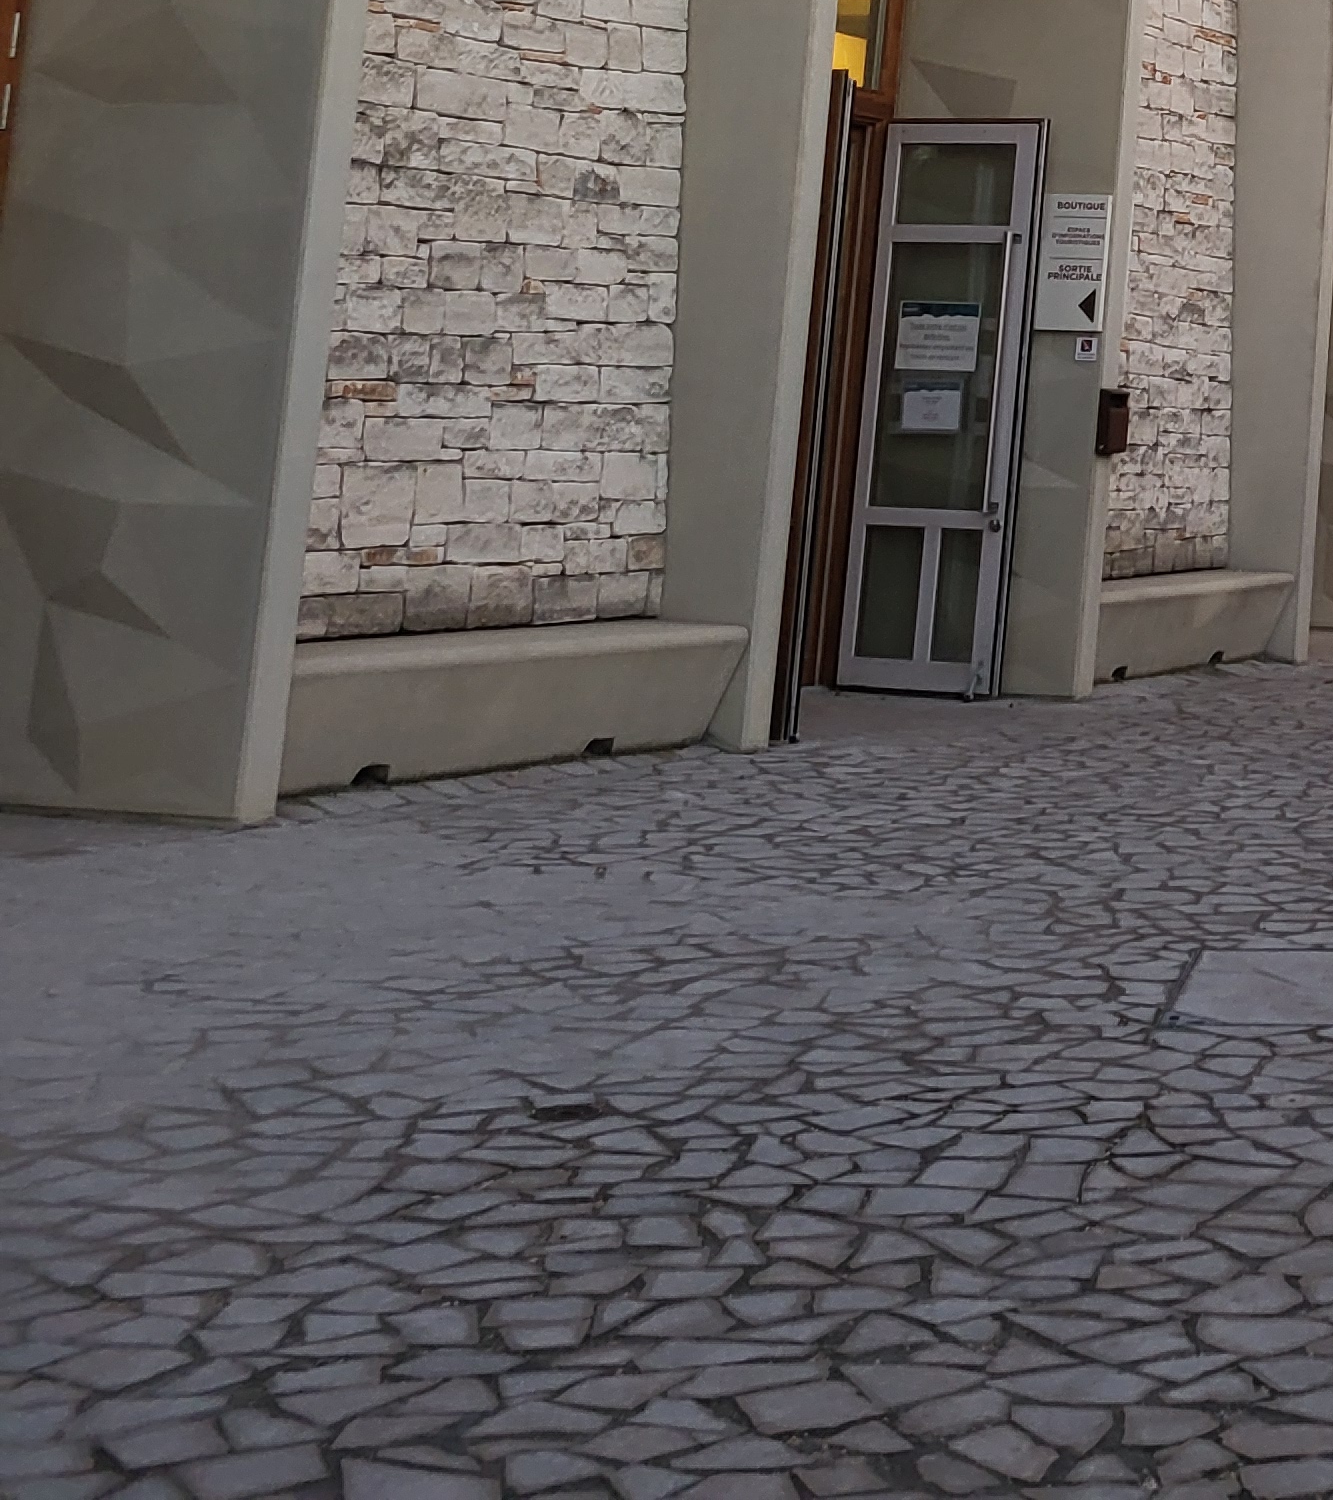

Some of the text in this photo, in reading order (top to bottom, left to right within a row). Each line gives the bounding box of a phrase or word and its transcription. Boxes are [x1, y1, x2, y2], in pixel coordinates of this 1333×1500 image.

[1057, 201, 1106, 211] BOUTIQUE
[1058, 264, 1093, 273] SORTIE
[1047, 272, 1102, 281] PRINCIPALE
